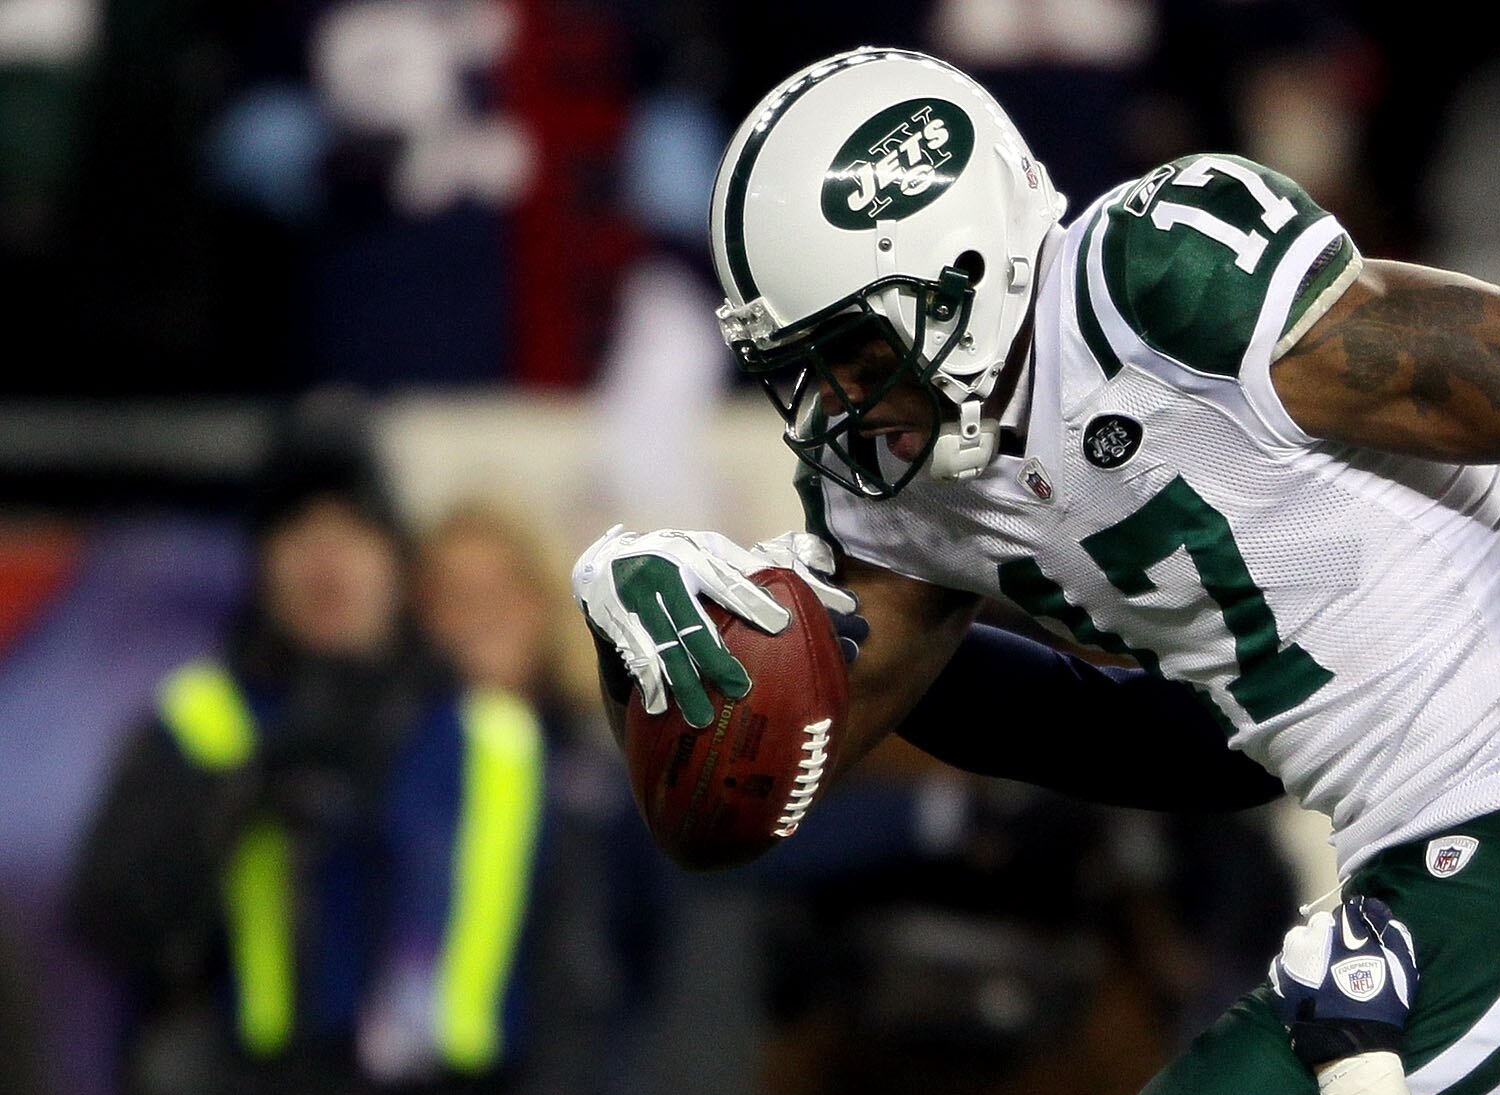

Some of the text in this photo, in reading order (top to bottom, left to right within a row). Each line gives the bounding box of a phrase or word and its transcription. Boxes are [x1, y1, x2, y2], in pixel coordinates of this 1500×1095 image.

[847, 118, 949, 211] JETS
[1151, 157, 1298, 275] 17
[1087, 428, 1128, 459] JETS
[997, 473, 1336, 735] 17
[1353, 979, 1373, 992] NFL
